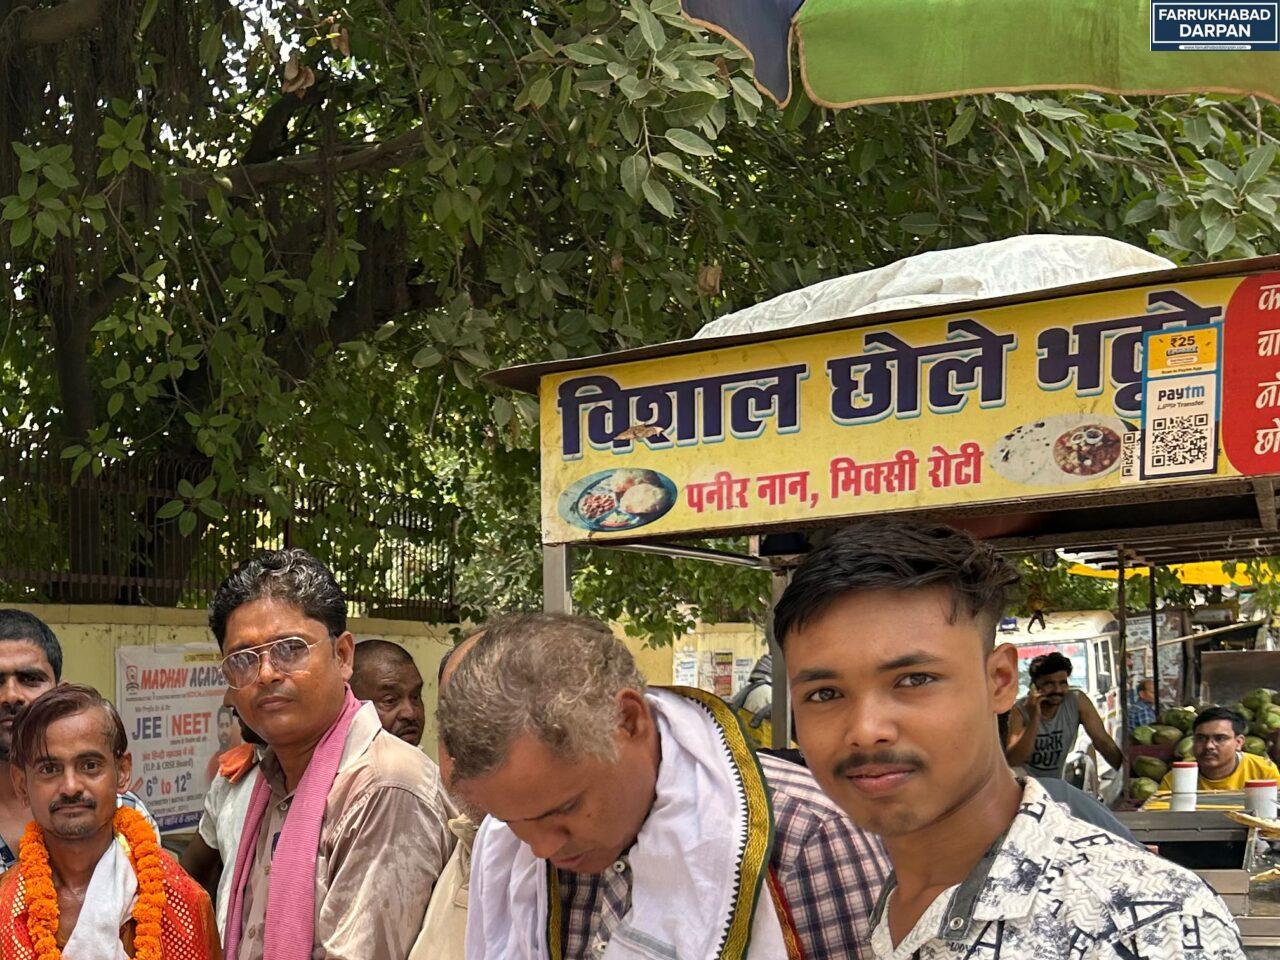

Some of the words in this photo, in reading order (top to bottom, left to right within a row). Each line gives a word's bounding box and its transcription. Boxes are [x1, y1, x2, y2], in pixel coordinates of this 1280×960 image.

[557, 362, 812, 459] विशाल
[826, 316, 1018, 424] छोले
[686, 470, 751, 513] पनीर
[756, 471, 820, 510] नान,
[928, 442, 985, 488] रोटी
[141, 668, 189, 690] MADHAV
[189, 665, 228, 688] ACADE
[132, 716, 162, 741] JEE
[171, 712, 212, 737] NEET
[161, 780, 172, 795] to
